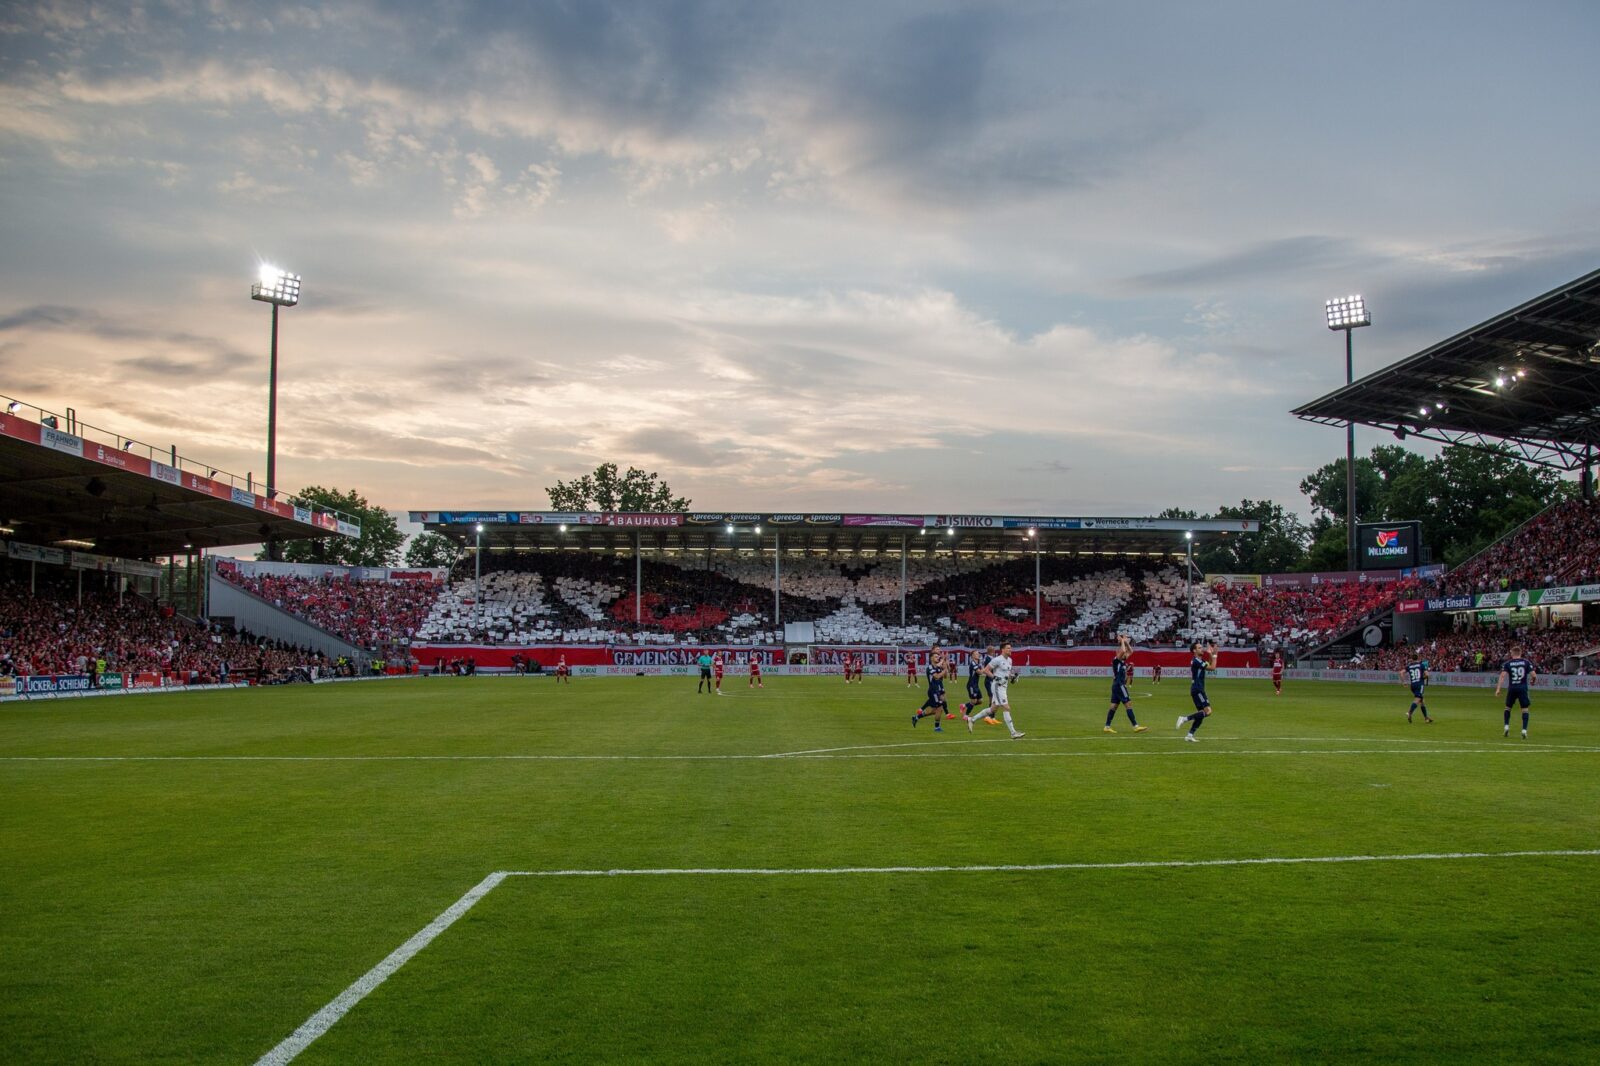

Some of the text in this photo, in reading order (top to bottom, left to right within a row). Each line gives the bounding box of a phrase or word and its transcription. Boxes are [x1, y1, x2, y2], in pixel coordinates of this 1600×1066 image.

[617, 516, 678, 525] BAUHAUS
[1428, 599, 1445, 609] Voller
[1446, 597, 1471, 608] Einsatz!
[1410, 669, 1421, 680] 30
[1511, 667, 1525, 680] 39
